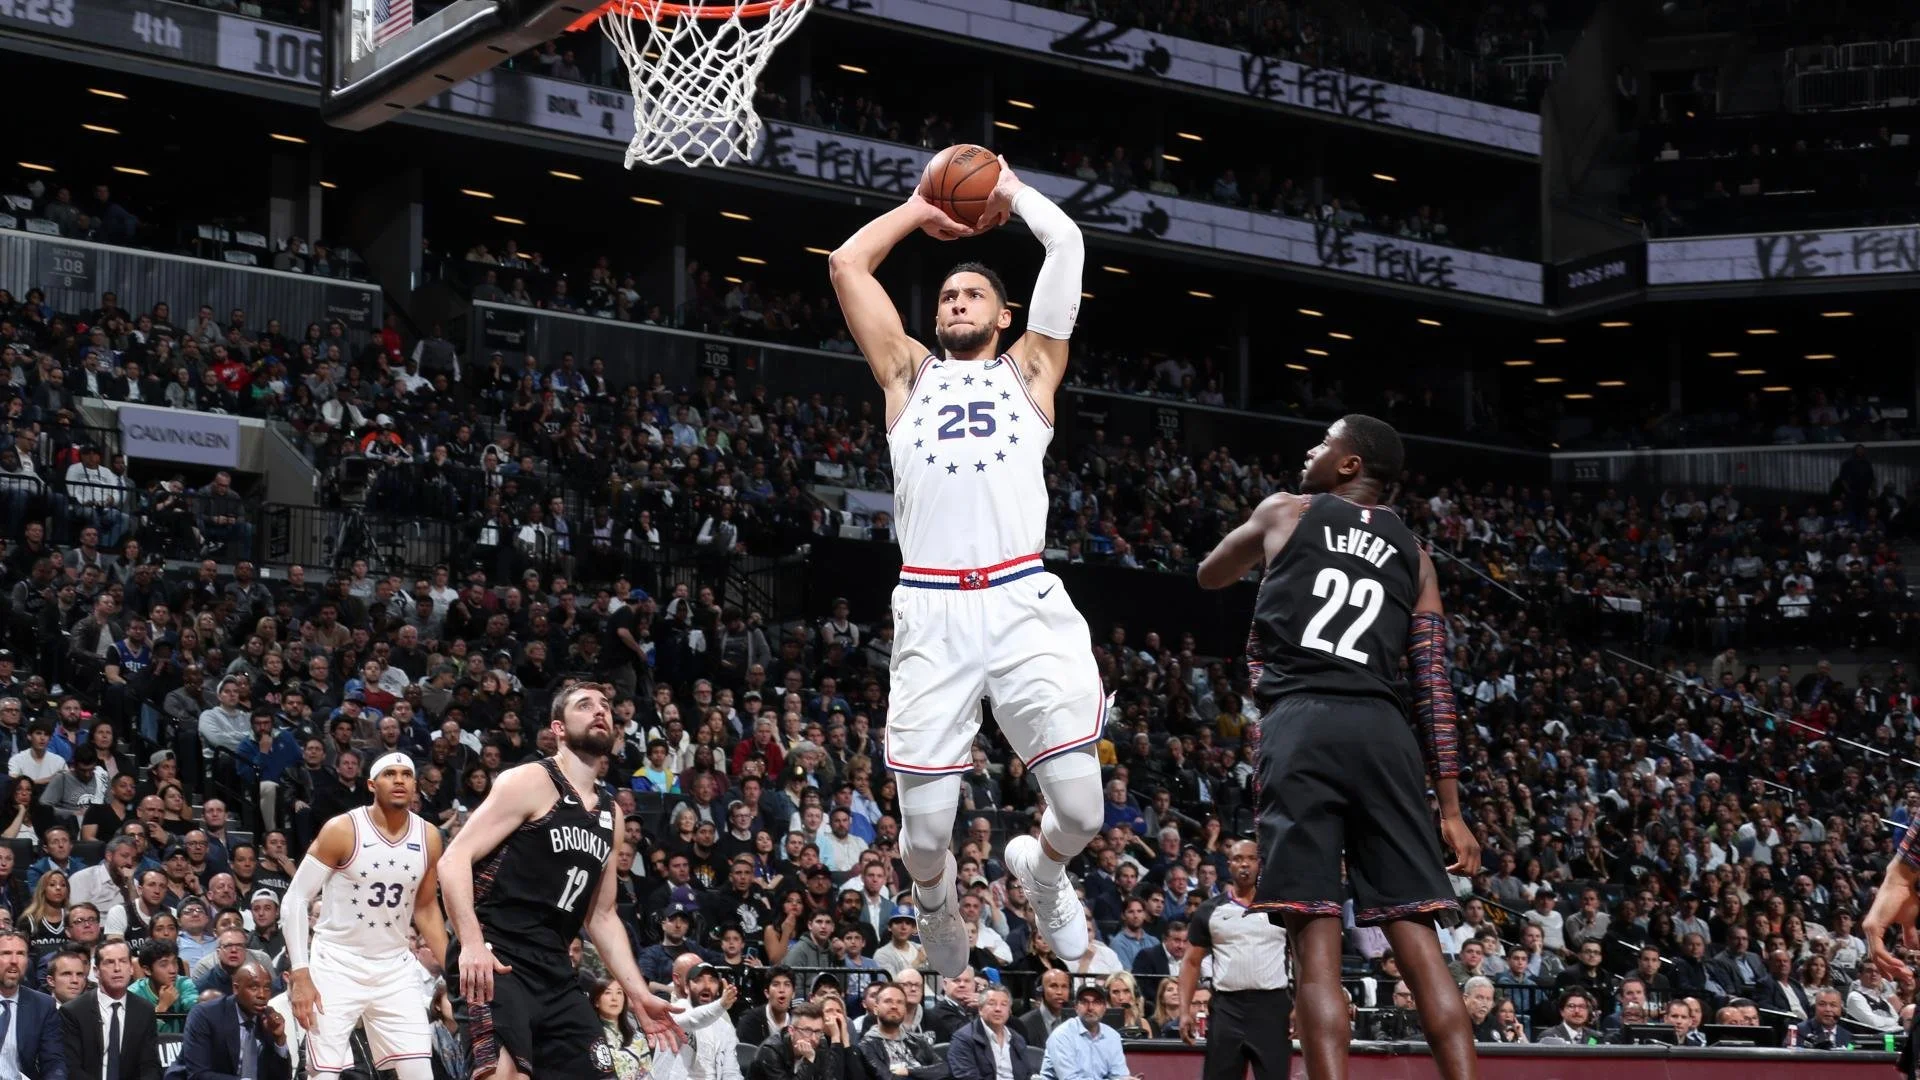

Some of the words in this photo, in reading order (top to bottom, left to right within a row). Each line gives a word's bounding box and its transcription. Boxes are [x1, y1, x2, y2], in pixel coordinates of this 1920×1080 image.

[132, 10, 183, 49] 4th
[252, 27, 323, 83] 106
[52, 256, 84, 274] 108
[704, 351, 729, 366] 109
[128, 423, 185, 445] CALVIN
[186, 429, 230, 450] KLEIN
[938, 401, 997, 441] 25
[1324, 526, 1399, 569] LeVERT
[1300, 567, 1386, 665] 22
[367, 881, 404, 908] 33
[557, 865, 590, 913] 12
